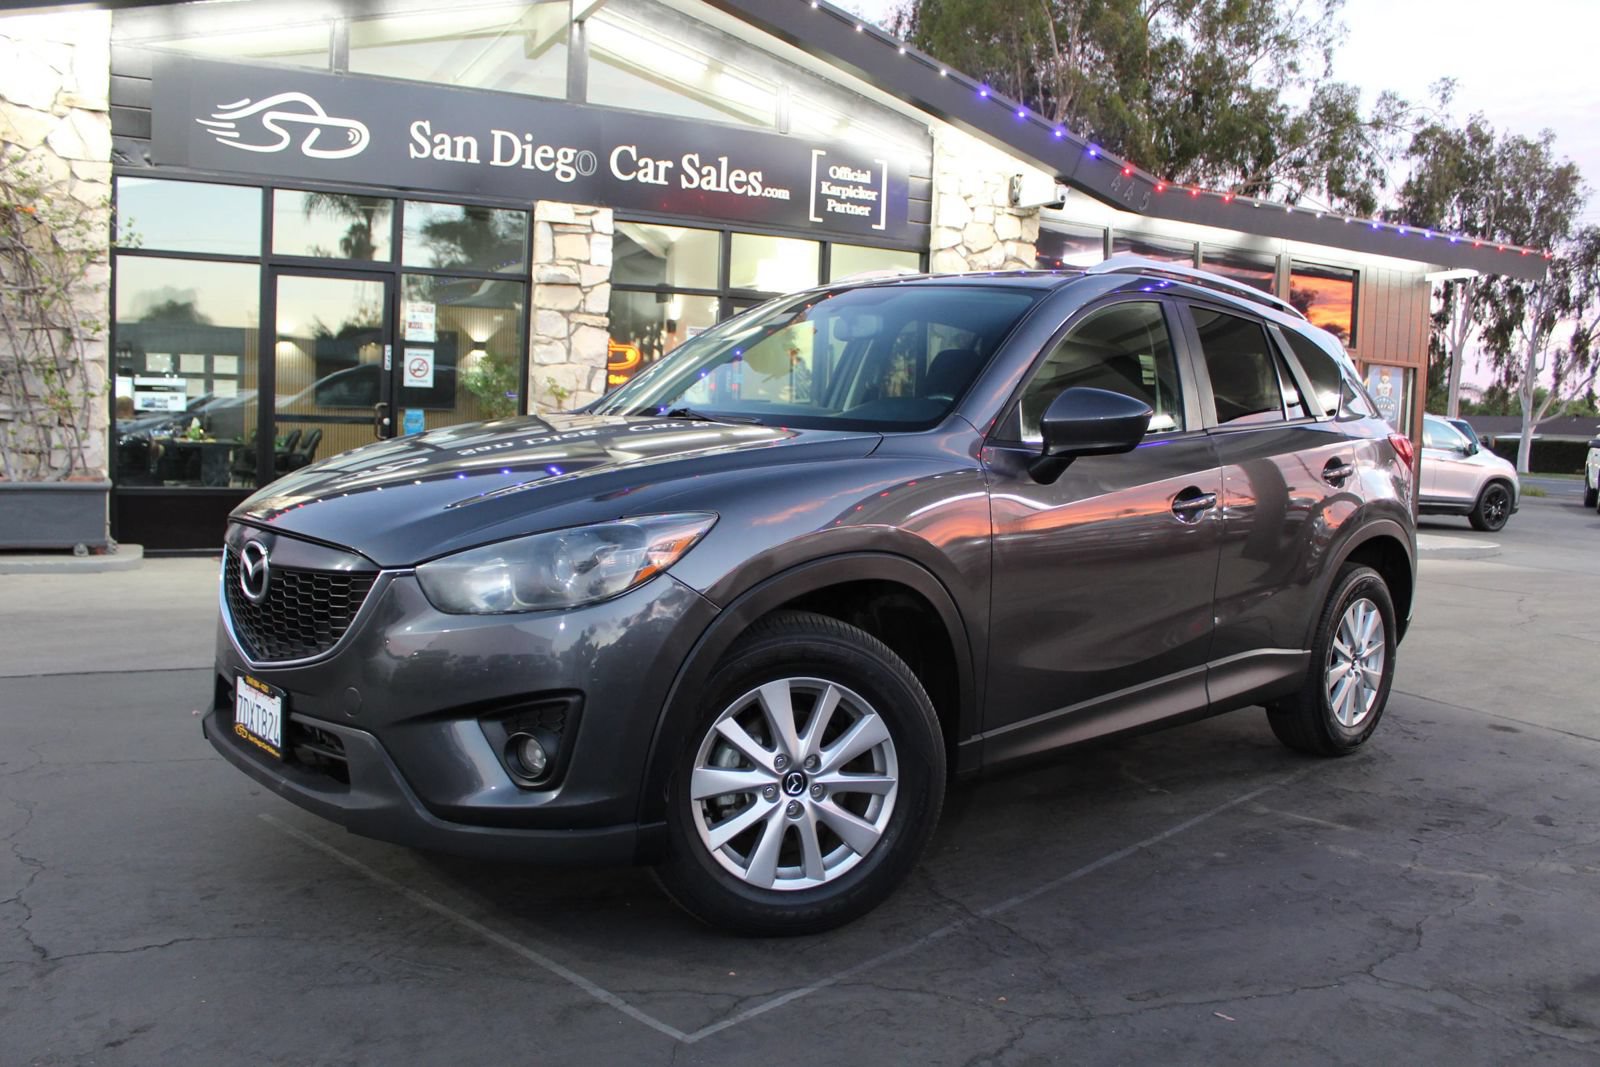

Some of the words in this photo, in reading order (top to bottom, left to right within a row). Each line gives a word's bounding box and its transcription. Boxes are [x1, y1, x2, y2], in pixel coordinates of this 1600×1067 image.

[409, 120, 480, 164] San
[490, 129, 598, 183] Diego
[609, 145, 674, 185] Car
[828, 165, 872, 184] Official
[820, 181, 878, 201] Karpicker
[826, 198, 871, 217] Partner
[238, 693, 281, 746] 7DXT824
